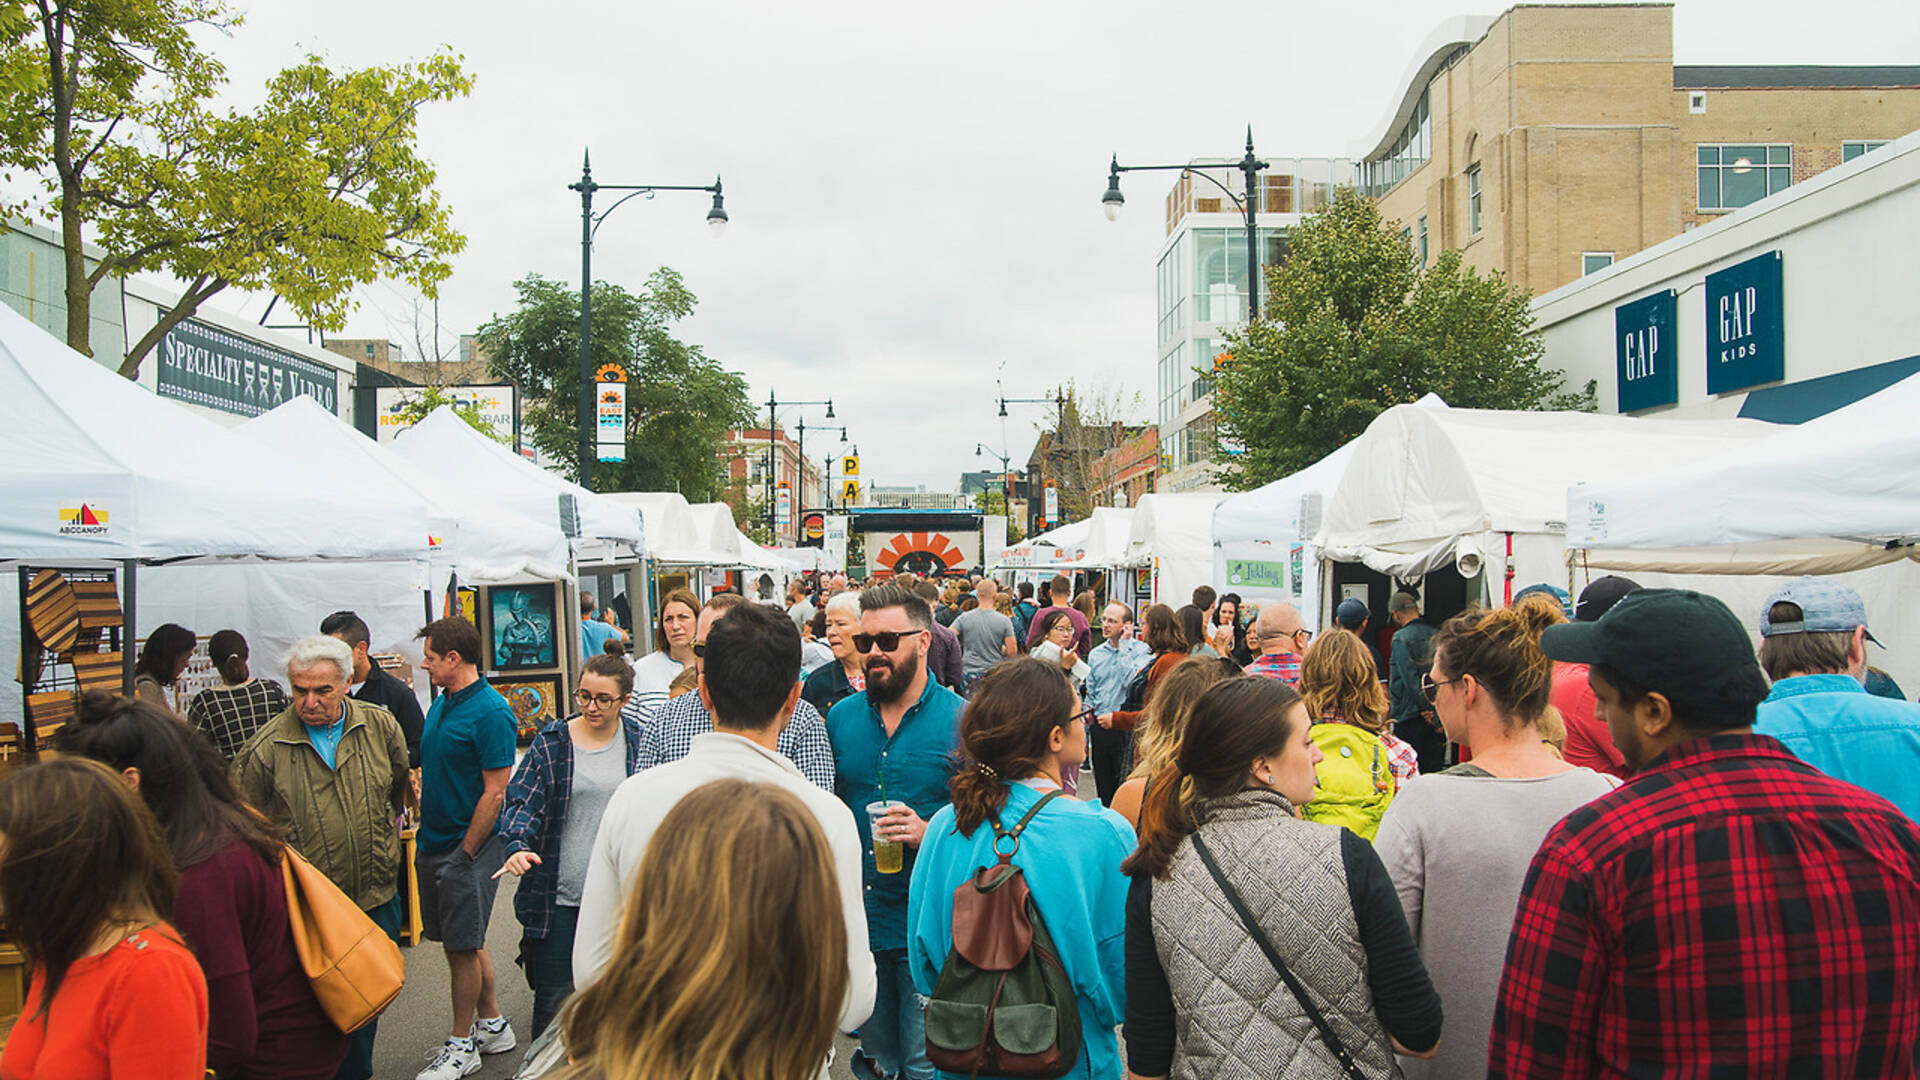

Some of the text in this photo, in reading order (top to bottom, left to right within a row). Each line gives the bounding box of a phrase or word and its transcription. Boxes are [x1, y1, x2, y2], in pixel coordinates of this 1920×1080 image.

[1720, 286, 1756, 343] GAP
[165, 331, 241, 386] SPECIALTY
[1625, 325, 1659, 381] GAP
[1721, 343, 1756, 363] KIDS
